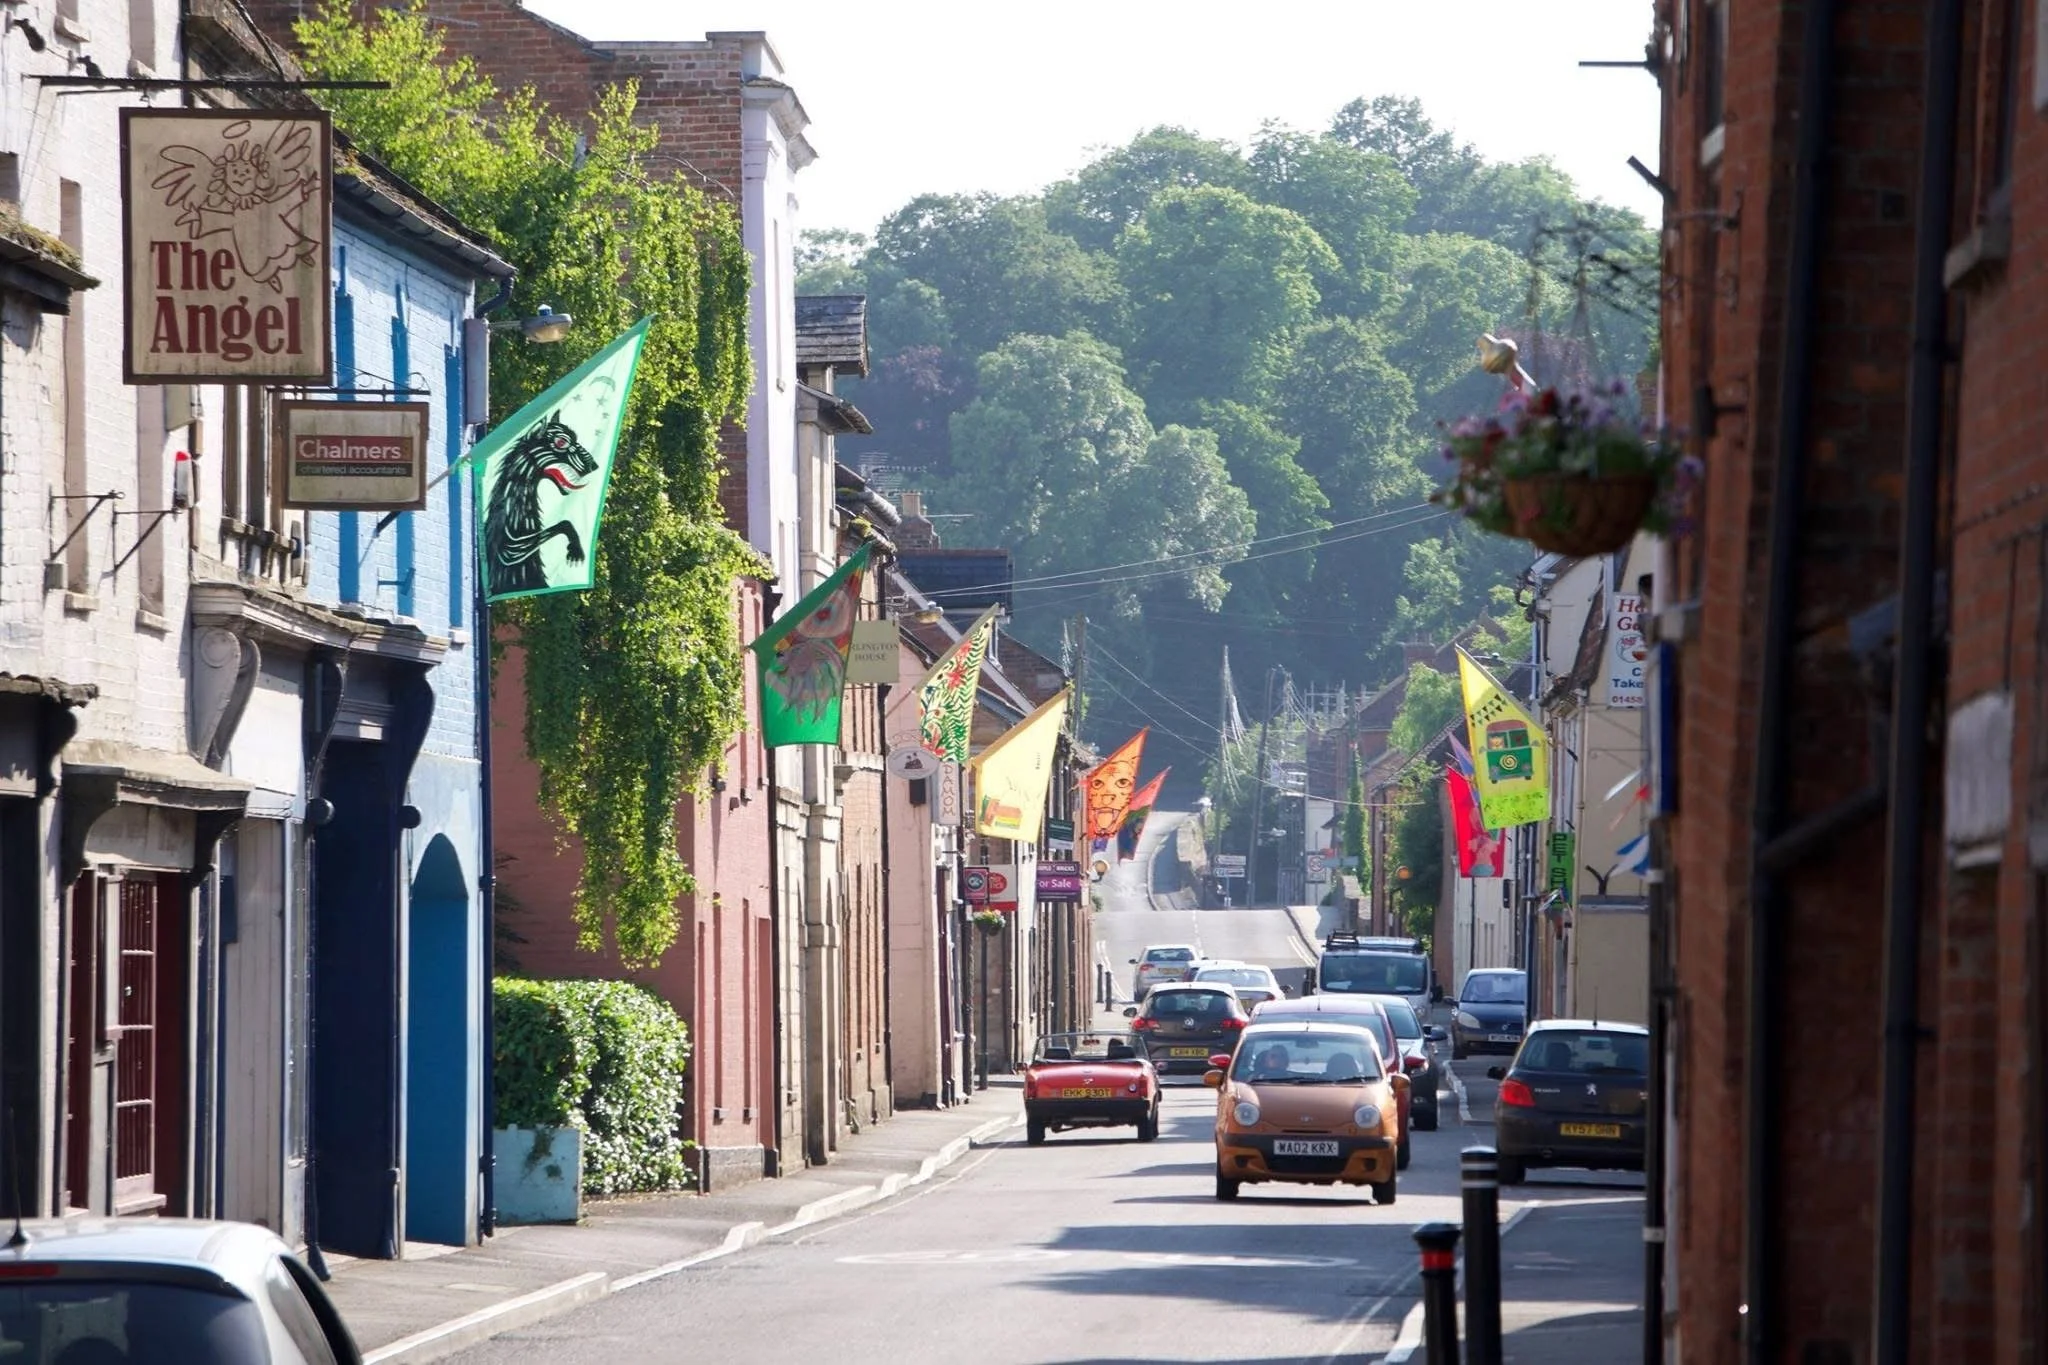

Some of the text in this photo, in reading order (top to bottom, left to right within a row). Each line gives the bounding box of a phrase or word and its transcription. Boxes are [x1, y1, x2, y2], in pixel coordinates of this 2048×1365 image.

[150, 240, 236, 291] The
[150, 295, 304, 363] Angel
[299, 439, 402, 460] Chalmers
[851, 643, 899, 651] RLINGTON
[854, 653, 886, 662] HOUSE
[1552, 832, 1568, 864] PET
[1051, 878, 1072, 888] Sale
[1310, 1142, 1335, 1155] KRX
